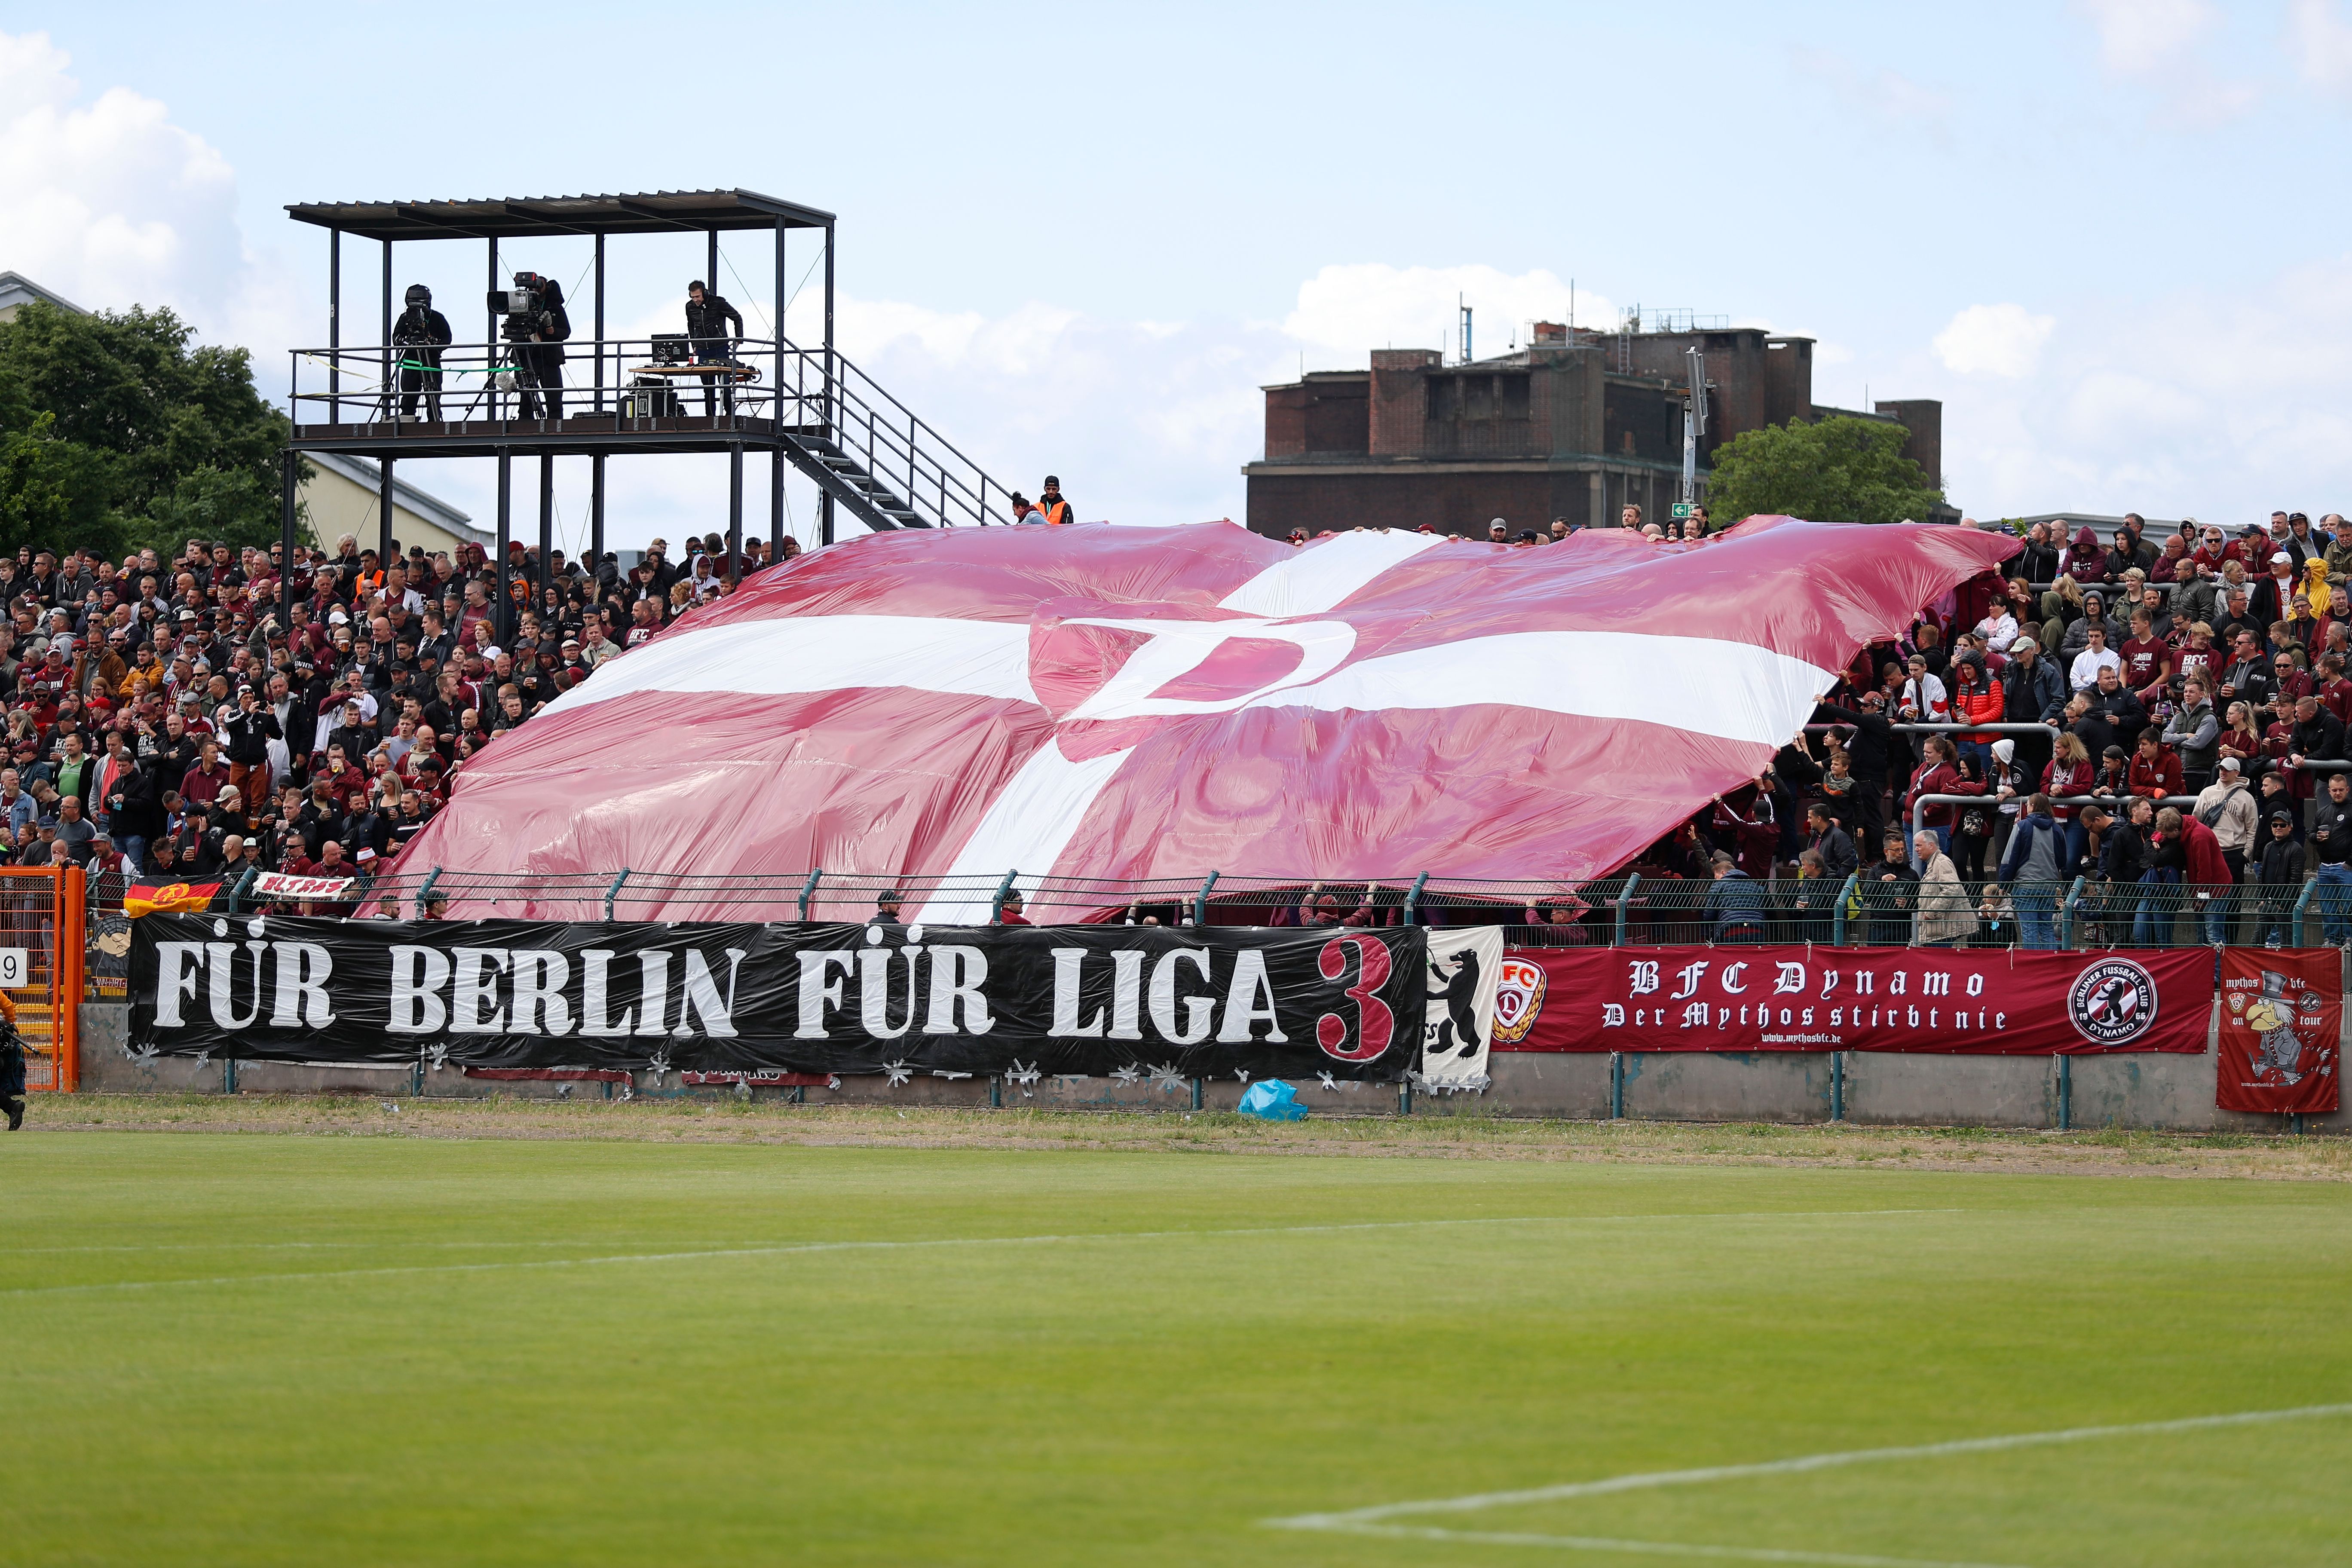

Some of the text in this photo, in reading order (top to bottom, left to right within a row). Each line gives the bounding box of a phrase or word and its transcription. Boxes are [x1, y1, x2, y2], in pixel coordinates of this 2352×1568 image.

[628, 629, 650, 639] BFC
[294, 660, 314, 670] UNION
[2182, 655, 2208, 665] BFC
[262, 876, 346, 894] ULTRAS
[1500, 965, 1536, 989] FC
[1773, 960, 1984, 1000] Dynamo
[2226, 977, 2306, 990] mythos bfc
[153, 918, 1394, 1062] FÜR BERLIN FÜR LIGA 3
[2077, 966, 2149, 1008] BERLINER FUSSBALL CLUB
[1602, 1001, 2007, 1030] Der Mythos stirbt nie
[2079, 1012, 2088, 1020] 19
[2232, 1015, 2322, 1025] on tour
[2089, 1023, 2135, 1037] DYNAMO
[1761, 1032, 1841, 1044] www.mythosbfc.de
